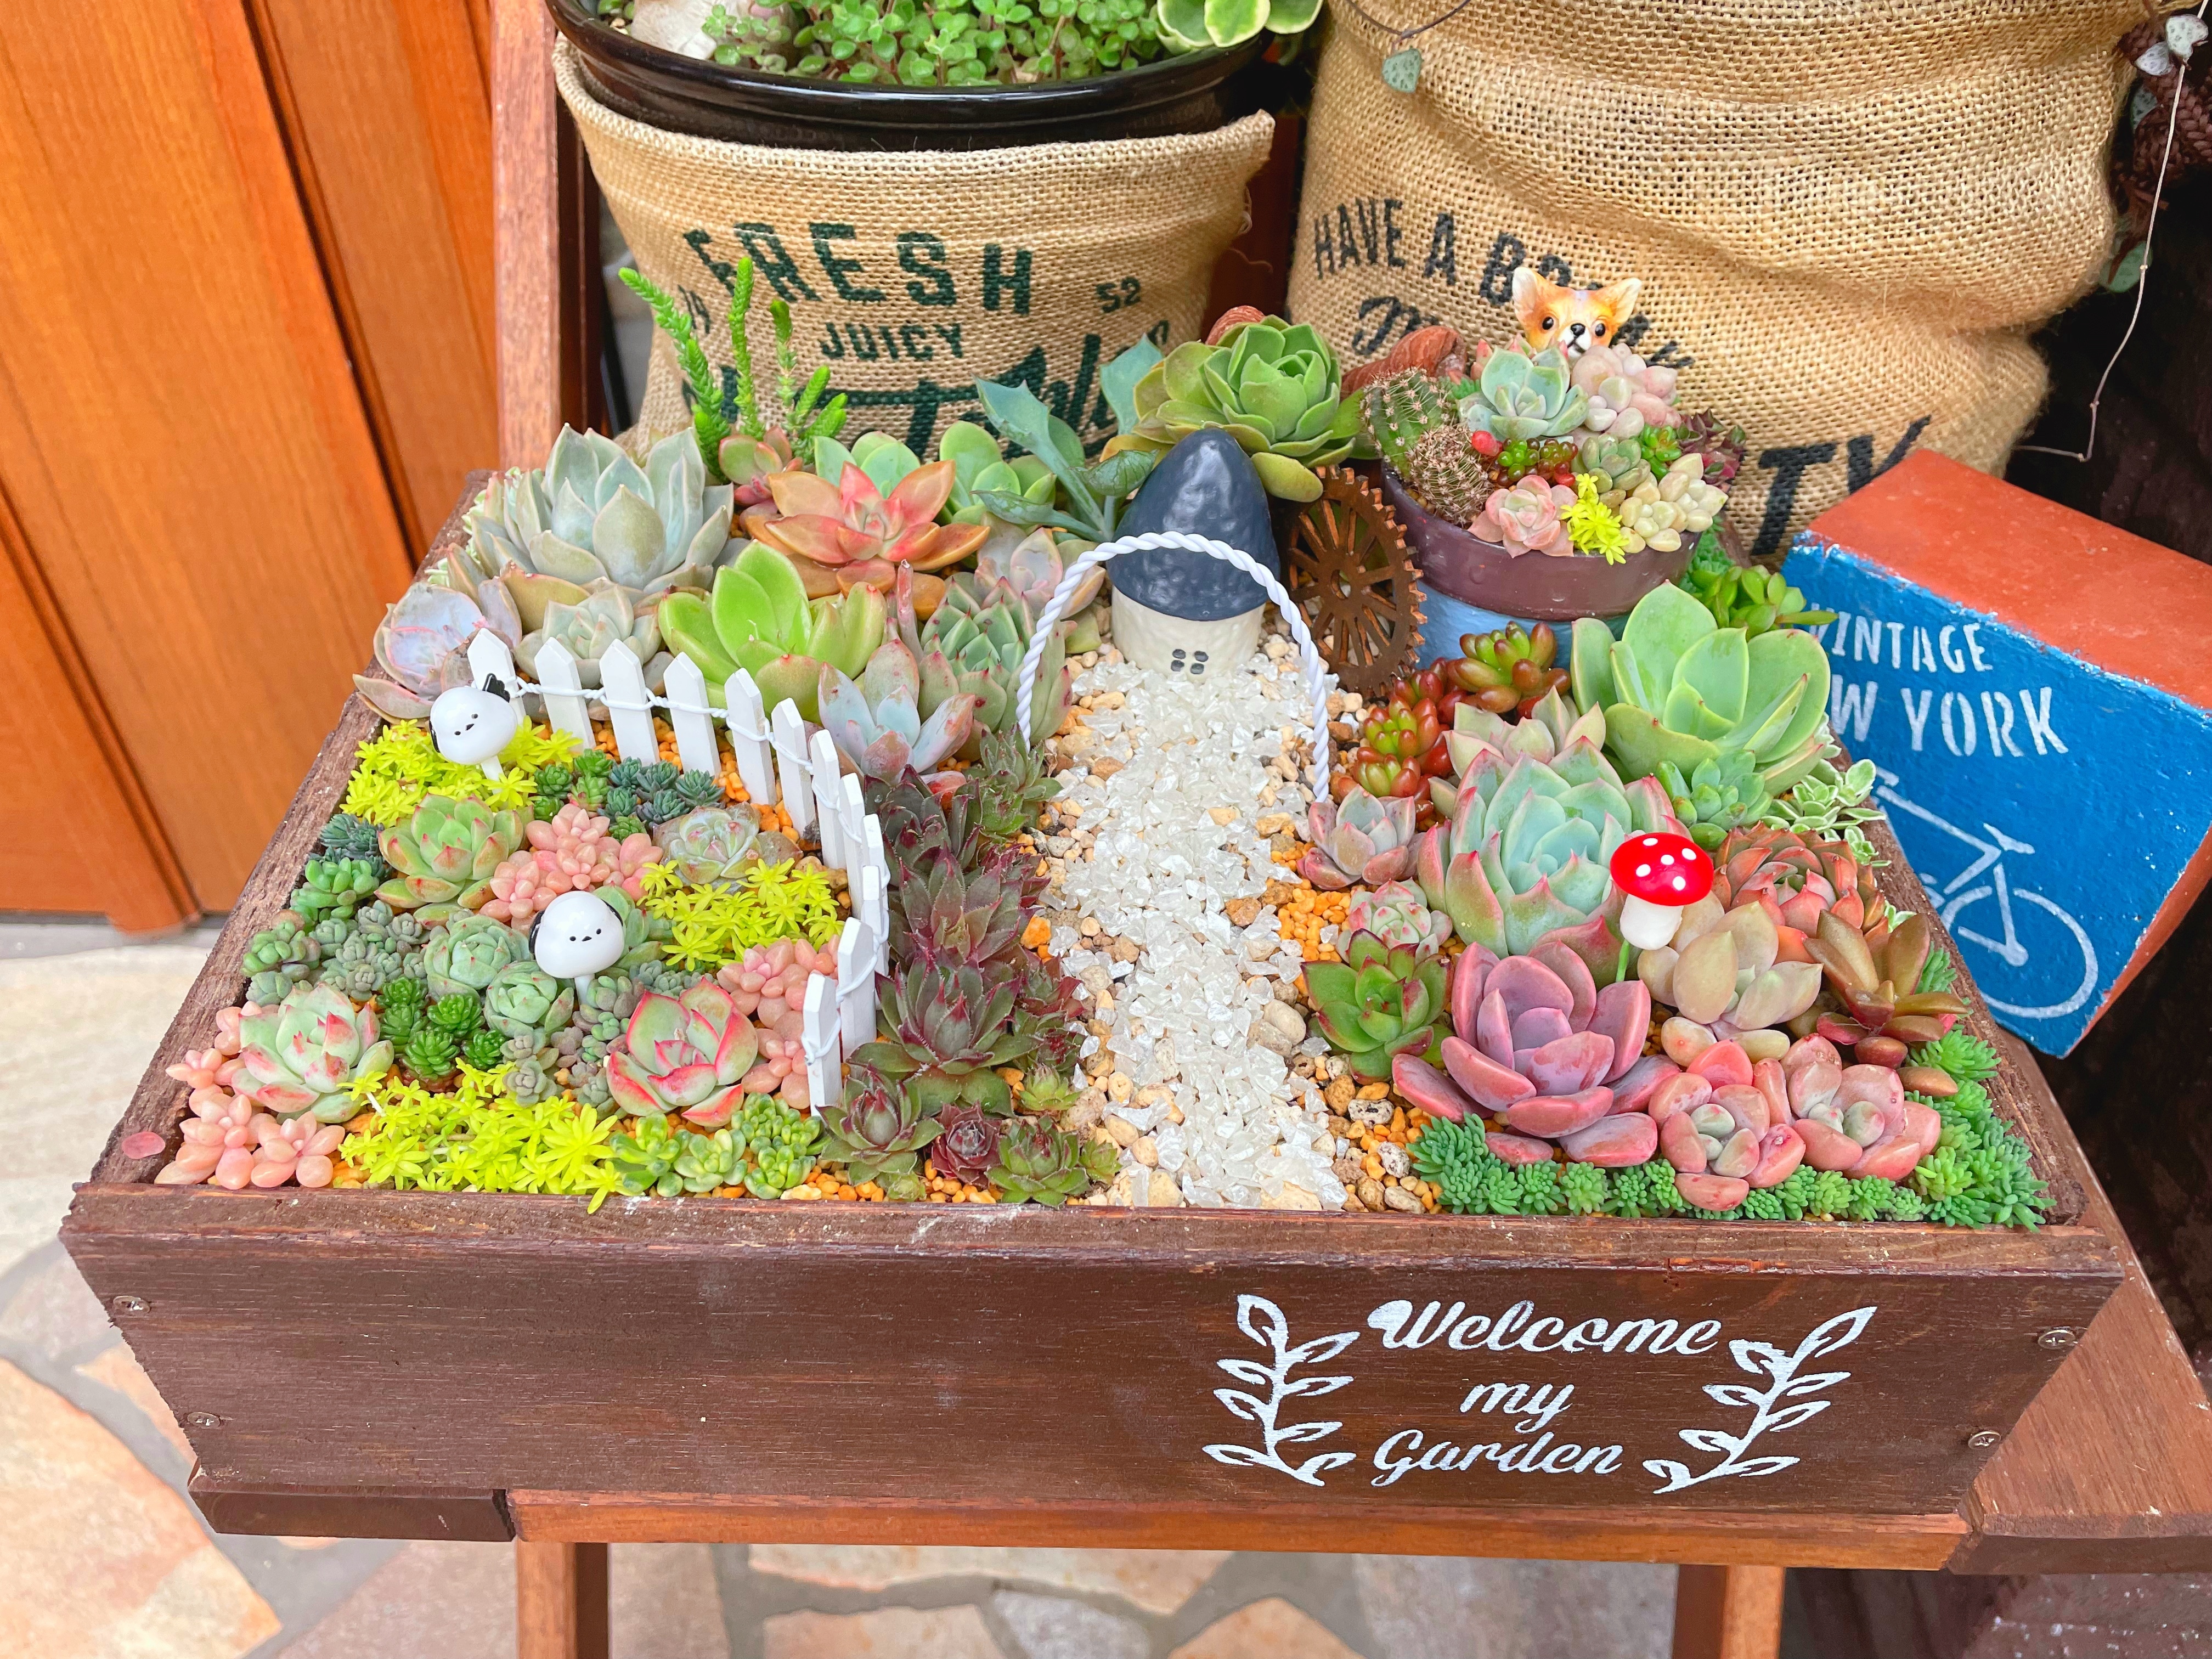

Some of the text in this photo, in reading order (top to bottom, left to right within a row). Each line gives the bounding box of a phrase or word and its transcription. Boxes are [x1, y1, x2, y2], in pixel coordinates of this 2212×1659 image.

[684, 222, 1033, 315] FRESH
[1316, 198, 1406, 279] HAVE
[1423, 212, 1455, 285] A
[1096, 276, 1141, 313] 52
[819, 320, 963, 360] JUICY
[1900, 686, 2068, 757] YORK
[1367, 1300, 1722, 1355] Welcome
[1460, 1383, 1574, 1434] my
[1371, 1429, 1623, 1487] Garden
